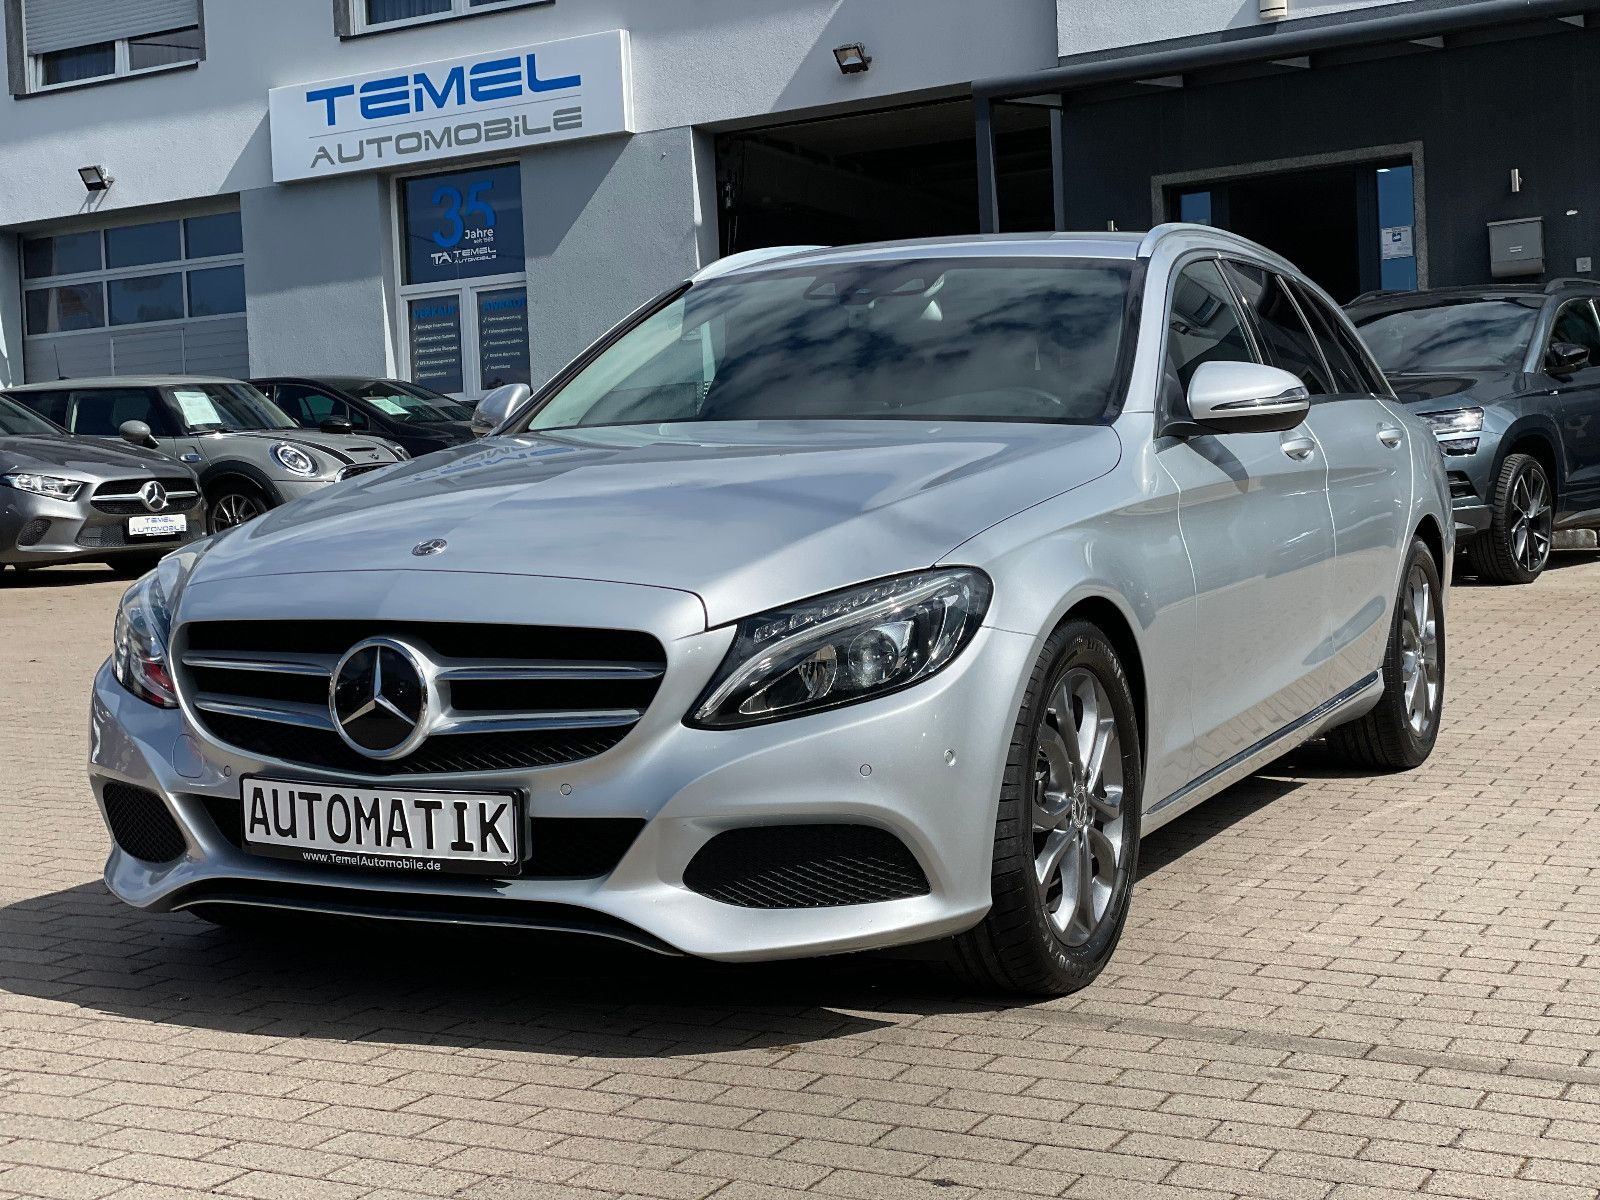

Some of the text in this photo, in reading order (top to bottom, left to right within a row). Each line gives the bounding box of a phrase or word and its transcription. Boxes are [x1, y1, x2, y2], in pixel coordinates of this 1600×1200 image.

[306, 53, 581, 127] TEMEL
[432, 181, 496, 248] 35
[465, 228, 494, 240] Jahre
[453, 247, 497, 258] TEMEL
[249, 787, 510, 854] AUTOMATIK
[303, 851, 441, 870] www.TemelAutomobile.de
